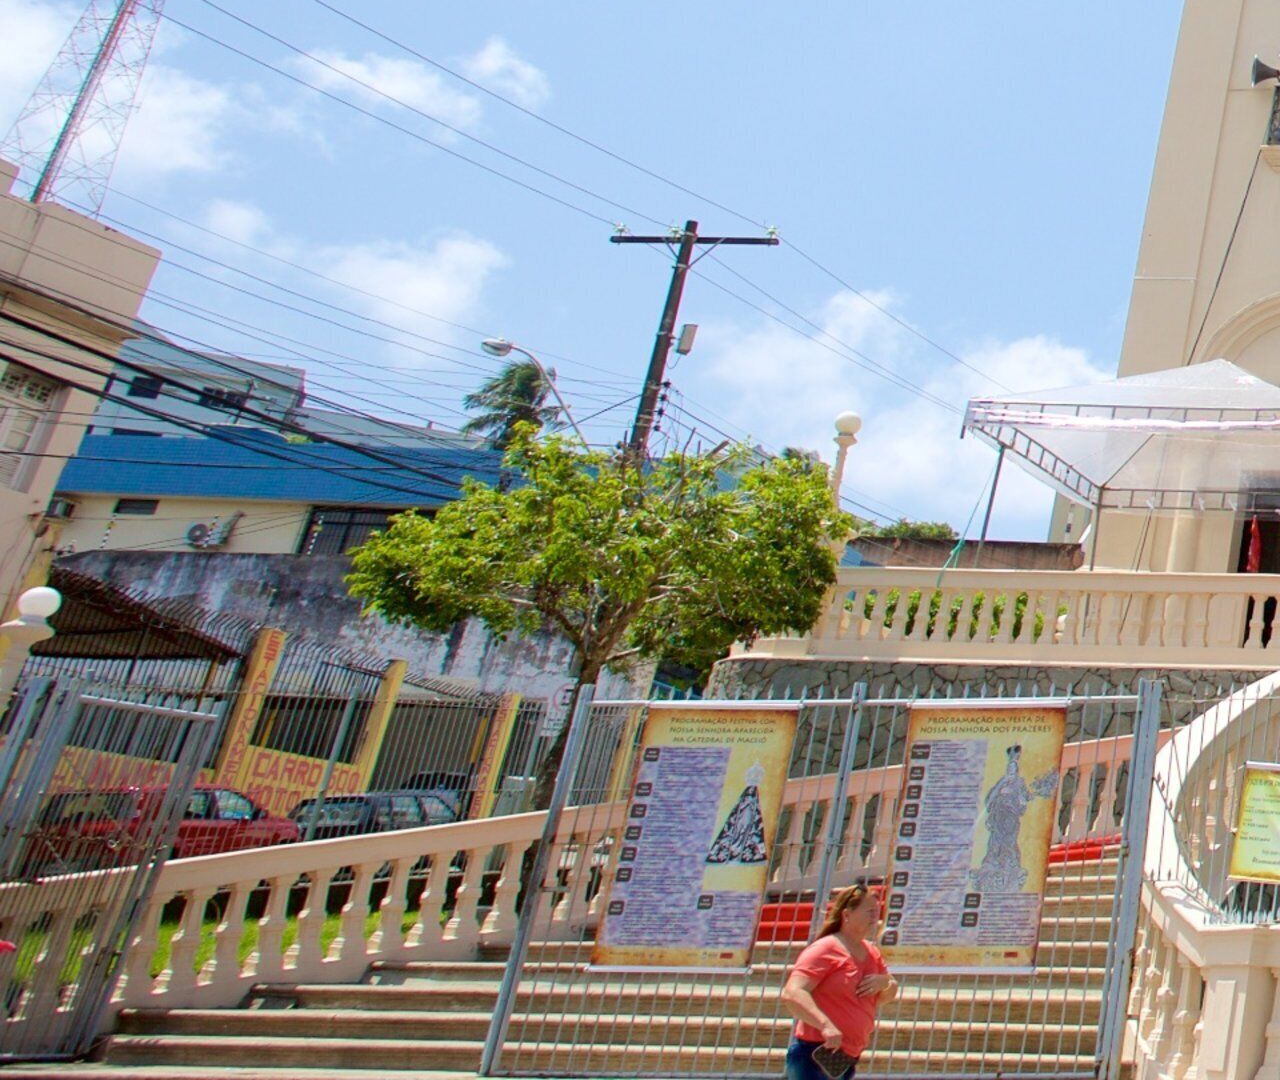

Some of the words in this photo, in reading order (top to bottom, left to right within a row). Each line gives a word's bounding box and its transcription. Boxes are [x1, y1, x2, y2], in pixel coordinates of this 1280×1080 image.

[927, 715, 993, 725] PROGRAMAÇÃO
[1012, 725, 1052, 733] PRAZERES
[252, 751, 324, 788] CARRO
